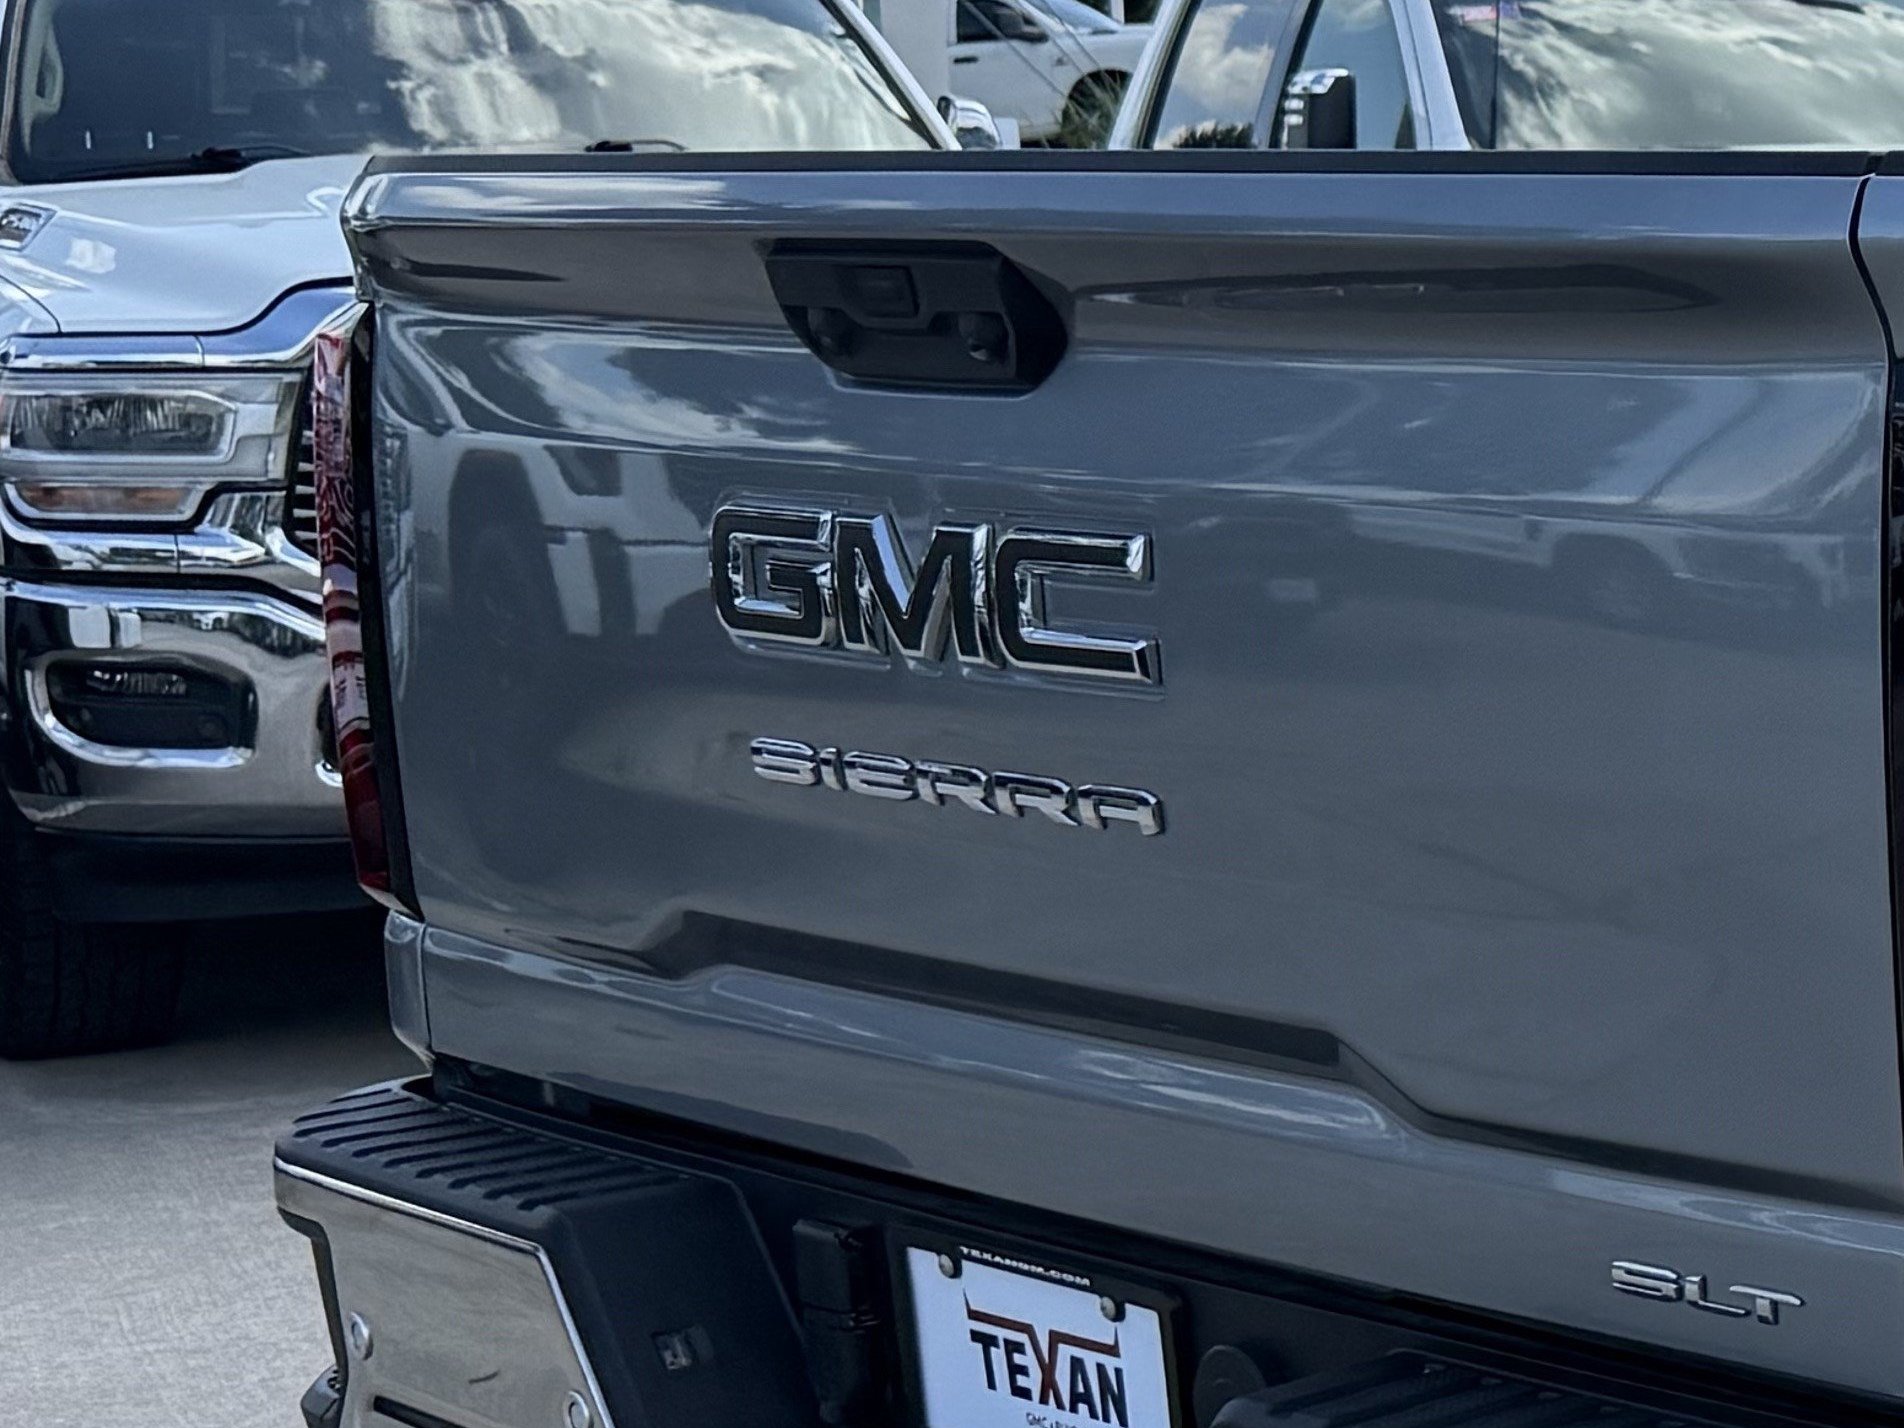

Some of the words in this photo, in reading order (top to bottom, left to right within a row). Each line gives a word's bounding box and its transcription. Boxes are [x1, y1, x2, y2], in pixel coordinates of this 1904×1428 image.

[709, 504, 1164, 686] GMC
[749, 735, 1166, 837] SIERRA
[1610, 1259, 1806, 1325] SLT
